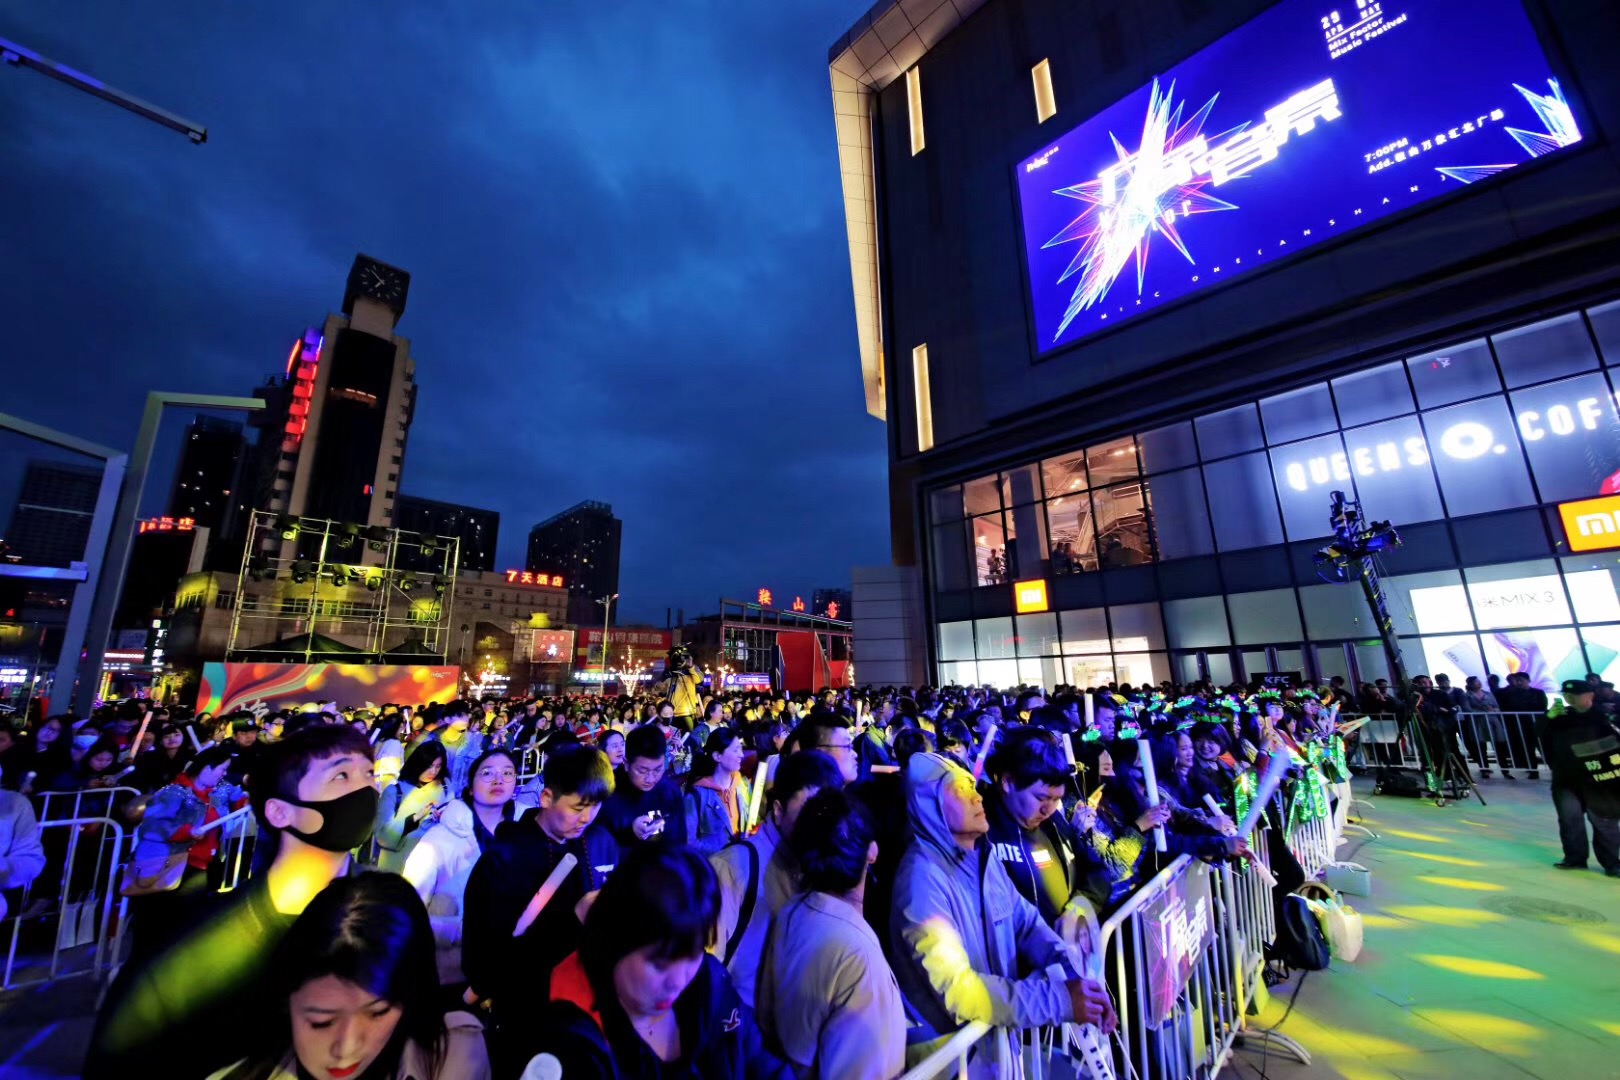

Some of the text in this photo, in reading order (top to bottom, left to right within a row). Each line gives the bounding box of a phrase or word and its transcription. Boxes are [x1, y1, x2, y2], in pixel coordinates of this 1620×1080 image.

[1331, 13, 1407, 59] Music Festival
[1350, 17, 1383, 39] Factor
[1364, 137, 1409, 162] 7:00PM
[1286, 437, 1430, 492] QUEENS
[506, 569, 564, 587] 7天酒店
[1543, 591, 1556, 604] 3
[1264, 676, 1289, 684] KFC
